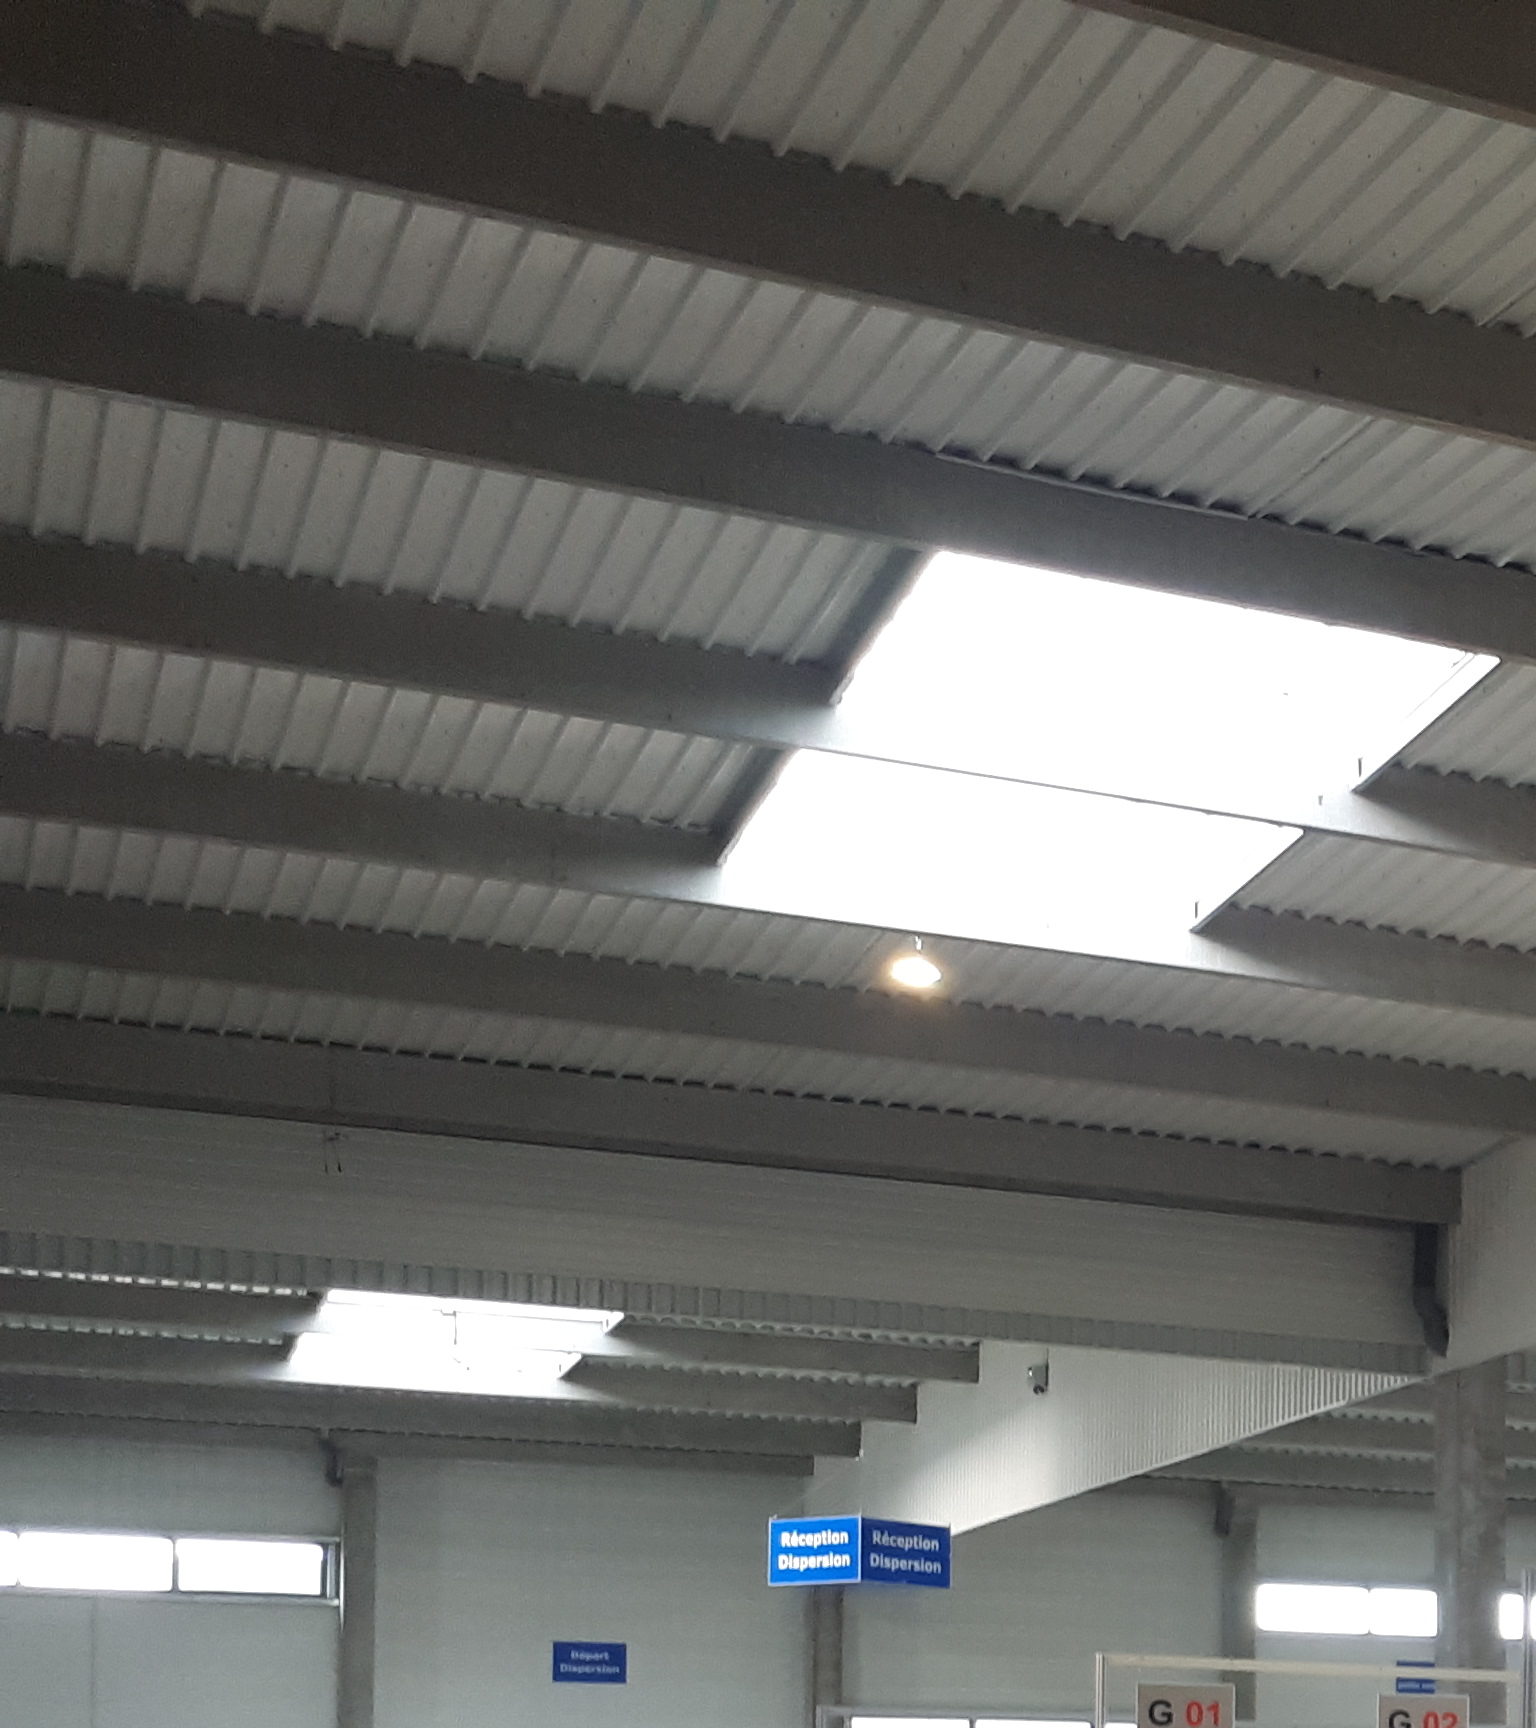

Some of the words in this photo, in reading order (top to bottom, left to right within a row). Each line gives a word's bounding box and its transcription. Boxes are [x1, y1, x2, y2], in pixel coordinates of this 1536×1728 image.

[780, 1529, 849, 1549] Réception
[871, 1529, 940, 1553] Réception
[778, 1551, 851, 1571] Dispersion
[869, 1552, 942, 1574] Dispersion
[559, 1663, 620, 1675] Dispersion
[1148, 1700, 1173, 1725] G
[1186, 1701, 1220, 1727] 01
